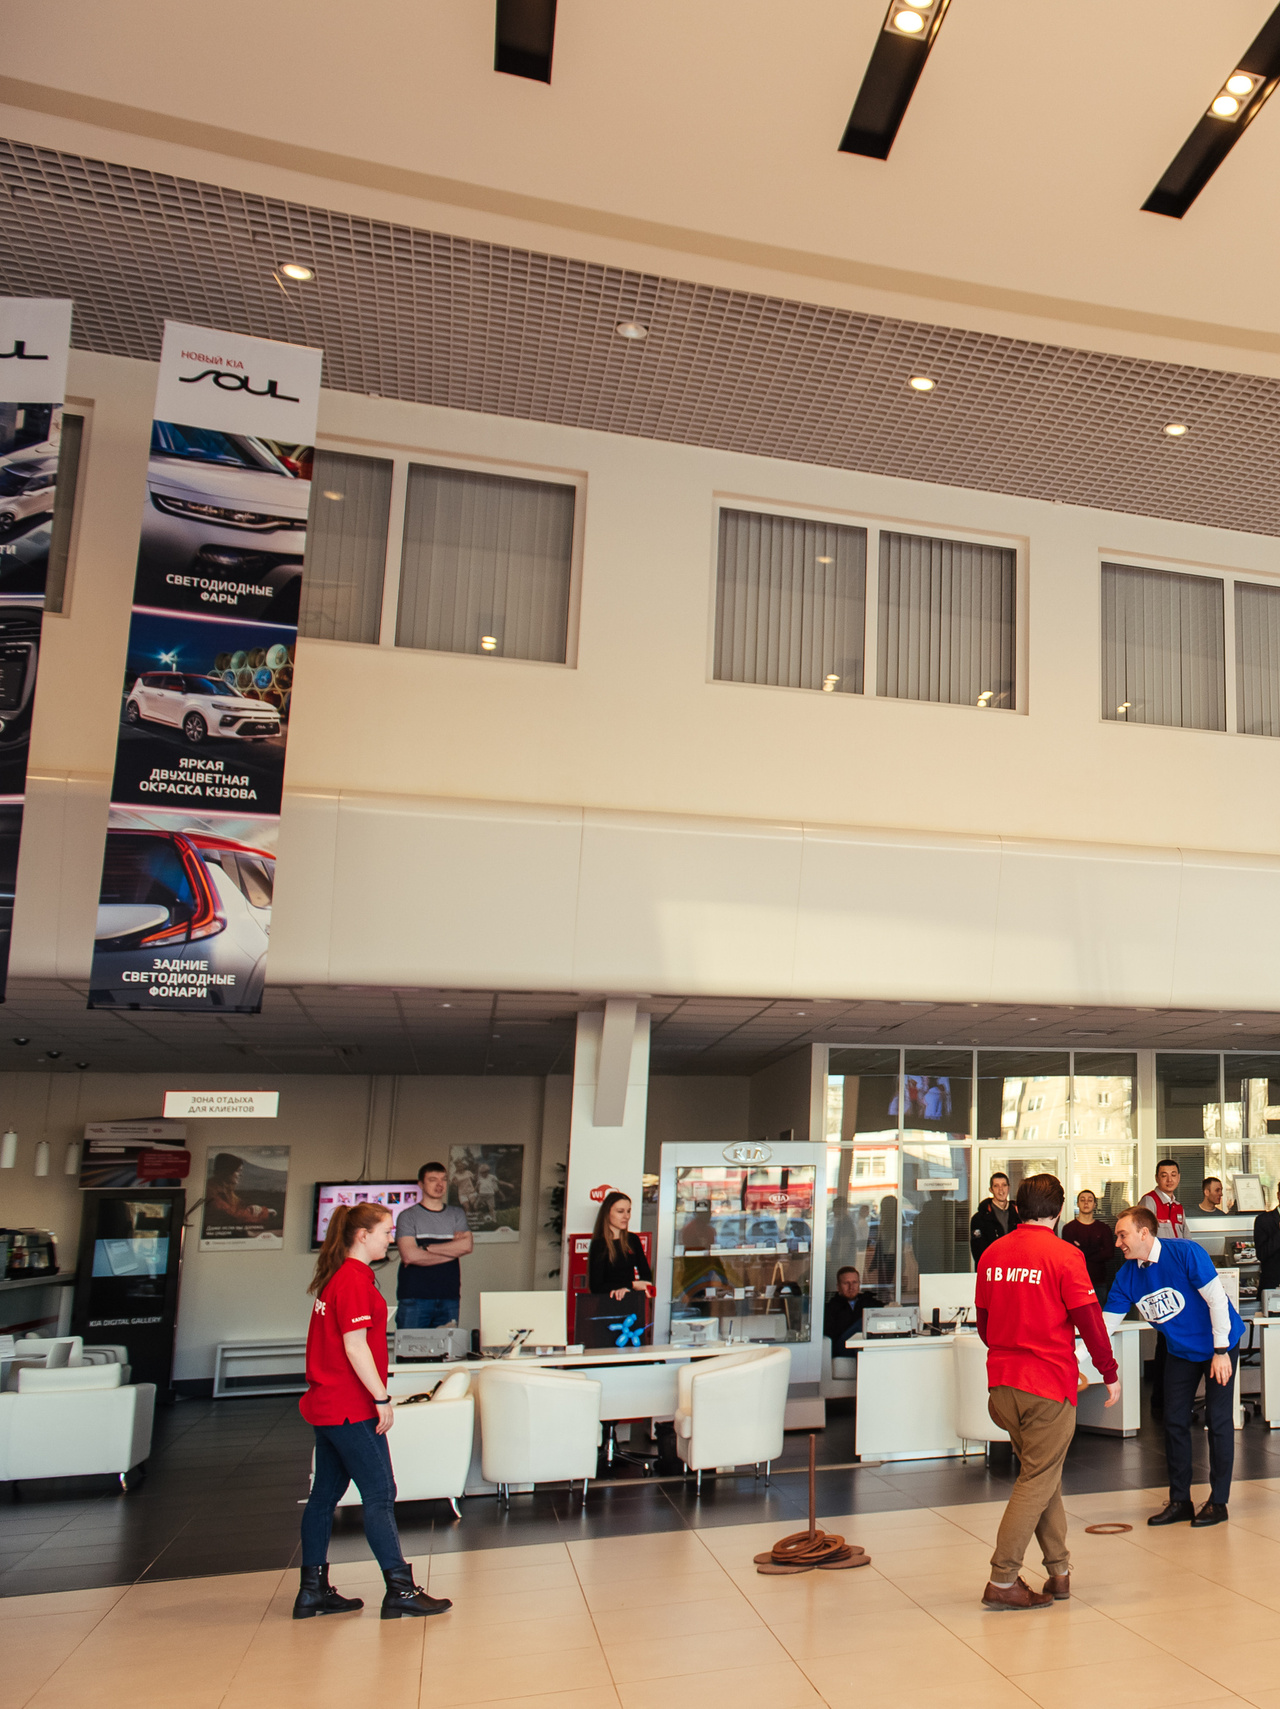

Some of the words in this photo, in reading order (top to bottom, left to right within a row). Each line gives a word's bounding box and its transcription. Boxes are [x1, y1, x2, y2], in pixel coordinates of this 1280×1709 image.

[181, 350, 223, 366] НОВЫЙ
[226, 359, 244, 369] KIA
[166, 573, 274, 597] СВЕТОДИОДНЫЕ
[200, 591, 238, 605] ФАРЫ
[179, 758, 224, 771] ЯРКАЯ
[149, 768, 249, 786] ДВУХЦВЕТНАЯ
[139, 781, 202, 796] ОКРАСКА
[205, 786, 257, 800] КУЗОВА
[152, 959, 209, 972] ЗАДНИЕ
[122, 971, 236, 986] СВЕТОДИОДНЫЕ
[149, 986, 207, 998] ФОНАРИ
[216, 1096, 254, 1104] ОТДЫХА
[188, 1105, 207, 1113] ДЛЯ
[209, 1105, 255, 1113] КЛИЕНТОВ
[733, 1147, 765, 1161] KIA
[986, 1267, 992, 1282] Я
[994, 1267, 1003, 1281] В
[1006, 1267, 1042, 1285] ИГРЕ!
[131, 1316, 162, 1324] GALLERY
